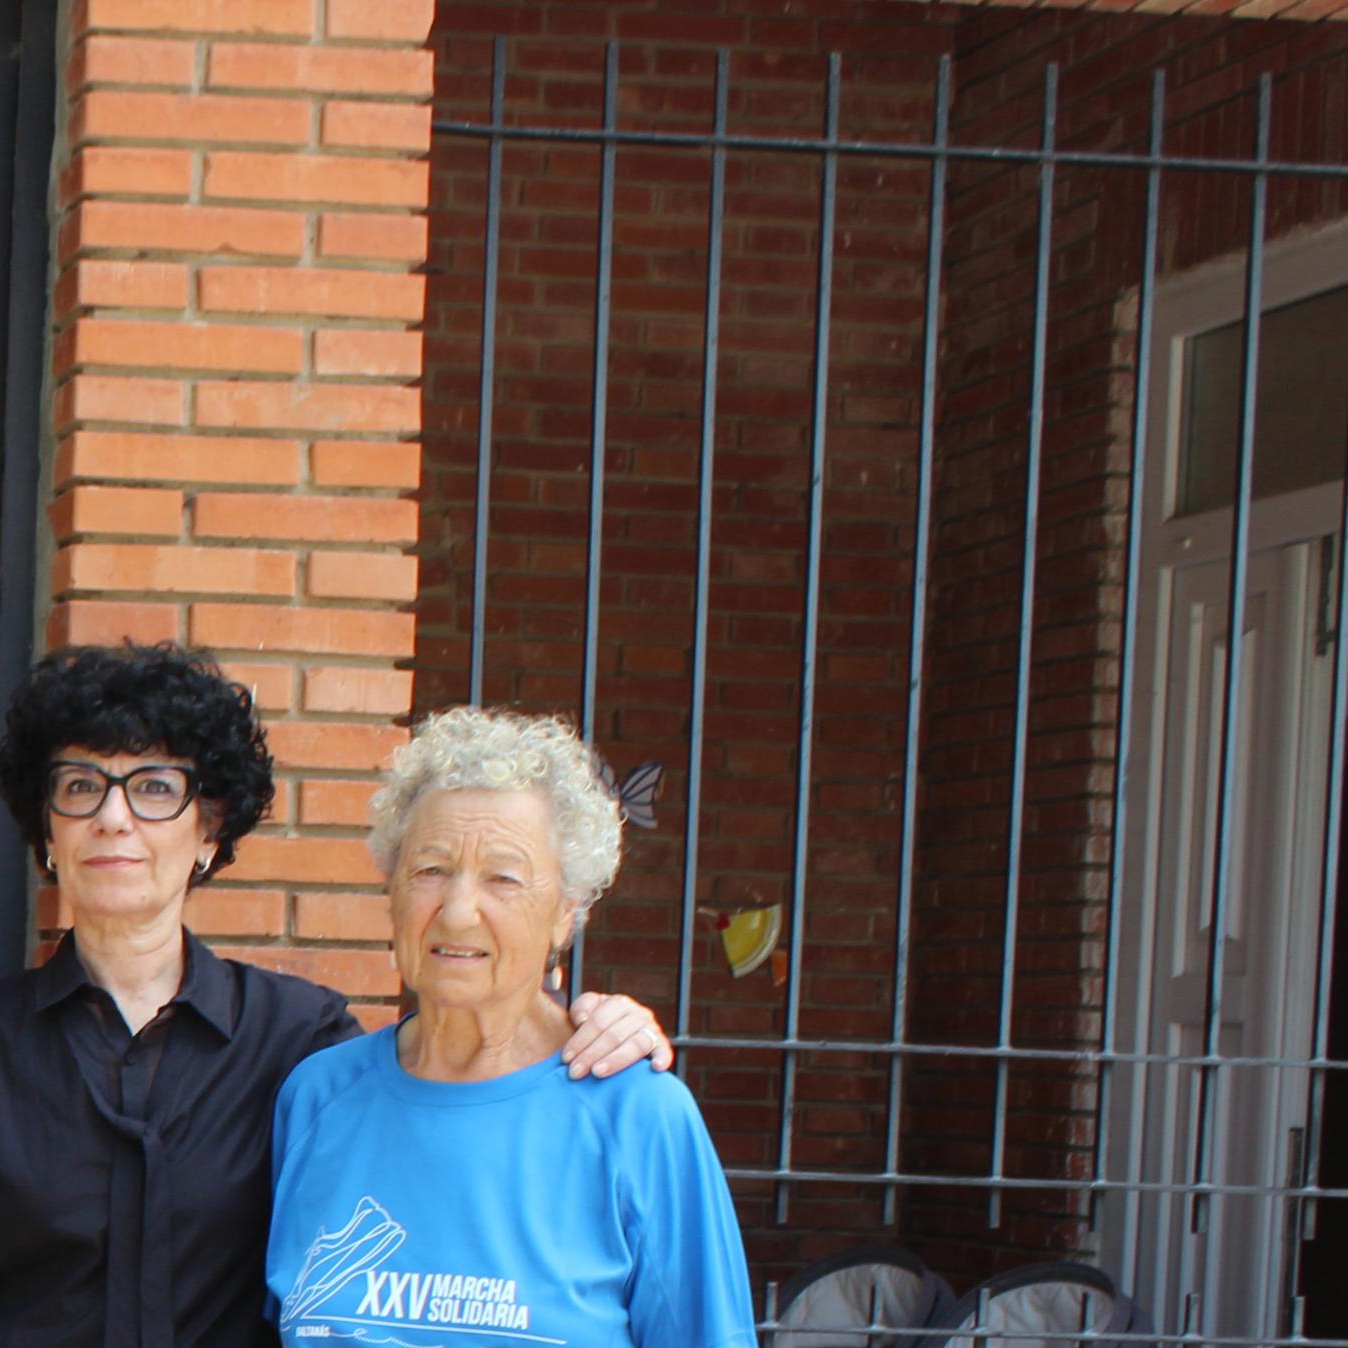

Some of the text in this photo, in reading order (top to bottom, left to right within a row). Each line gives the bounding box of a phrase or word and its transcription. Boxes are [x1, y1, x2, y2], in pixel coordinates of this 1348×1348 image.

[356, 1270, 517, 1320] XXV MARCHA
[427, 1298, 529, 1330] SOLIDARIA
